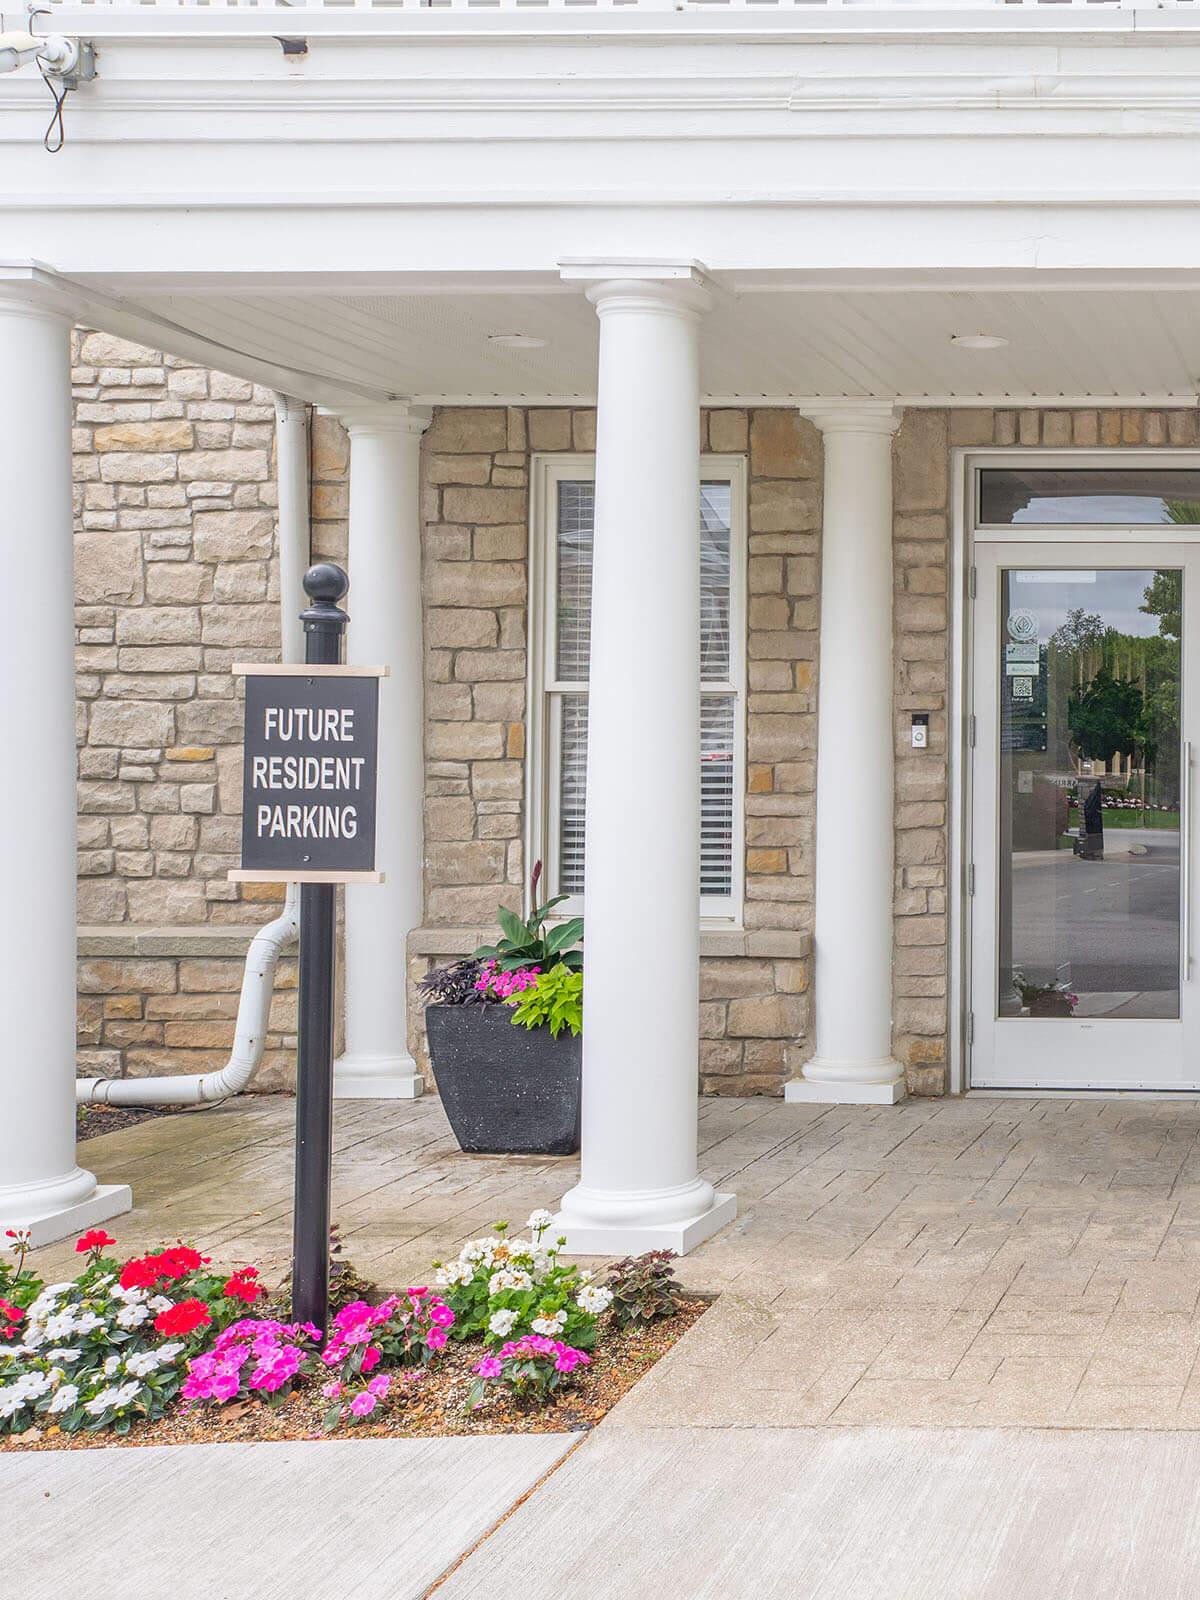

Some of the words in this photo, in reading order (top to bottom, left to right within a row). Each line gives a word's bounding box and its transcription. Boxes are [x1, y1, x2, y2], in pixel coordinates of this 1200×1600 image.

[264, 707, 354, 741] FUTURE
[252, 756, 365, 790] RESIDENT
[257, 805, 357, 839] PARKING
